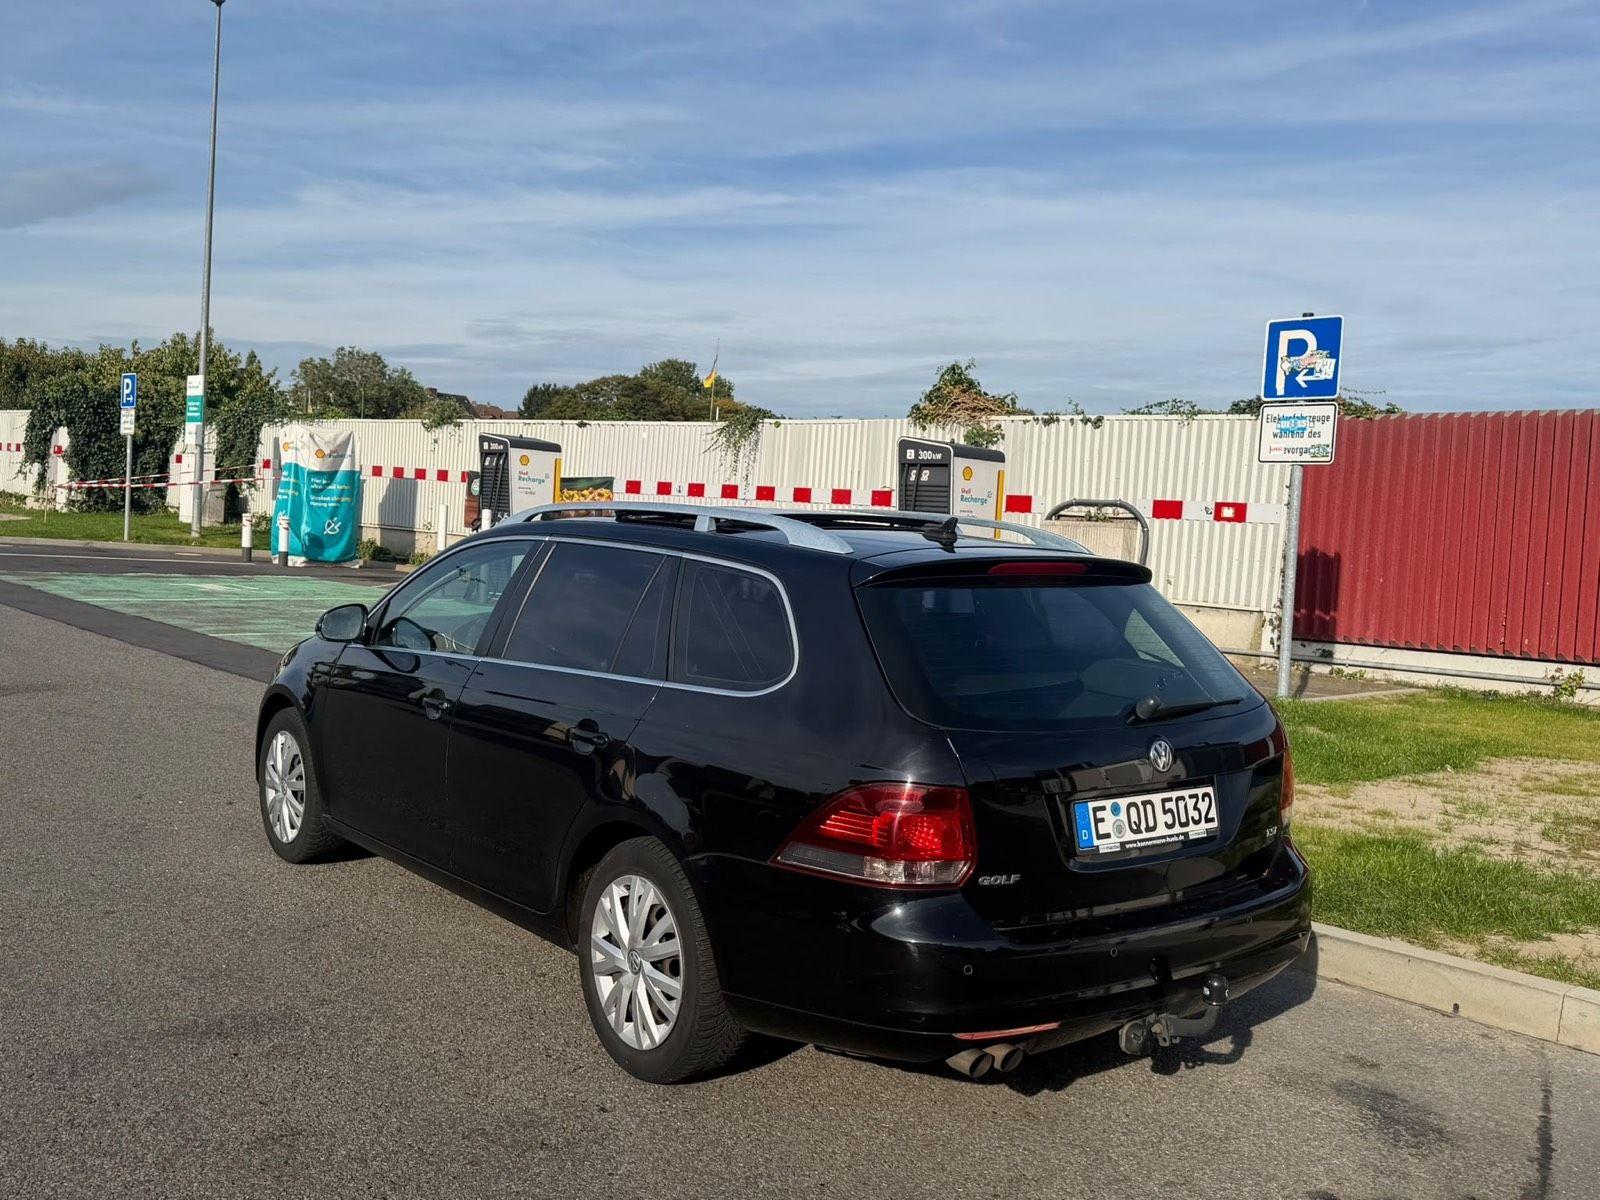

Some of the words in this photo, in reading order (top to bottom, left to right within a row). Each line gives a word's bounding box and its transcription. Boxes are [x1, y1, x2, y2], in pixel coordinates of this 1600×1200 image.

[1276, 329, 1317, 396] P
[123, 378, 132, 403] P
[1308, 429, 1321, 438] des
[518, 475, 545, 484] Recharge
[960, 495, 988, 506] Recharge
[1092, 805, 1111, 841] E
[1126, 799, 1158, 835] QD
[1161, 791, 1216, 830] 5032
[1082, 829, 1089, 840] D
[978, 874, 1021, 886] GOLF
